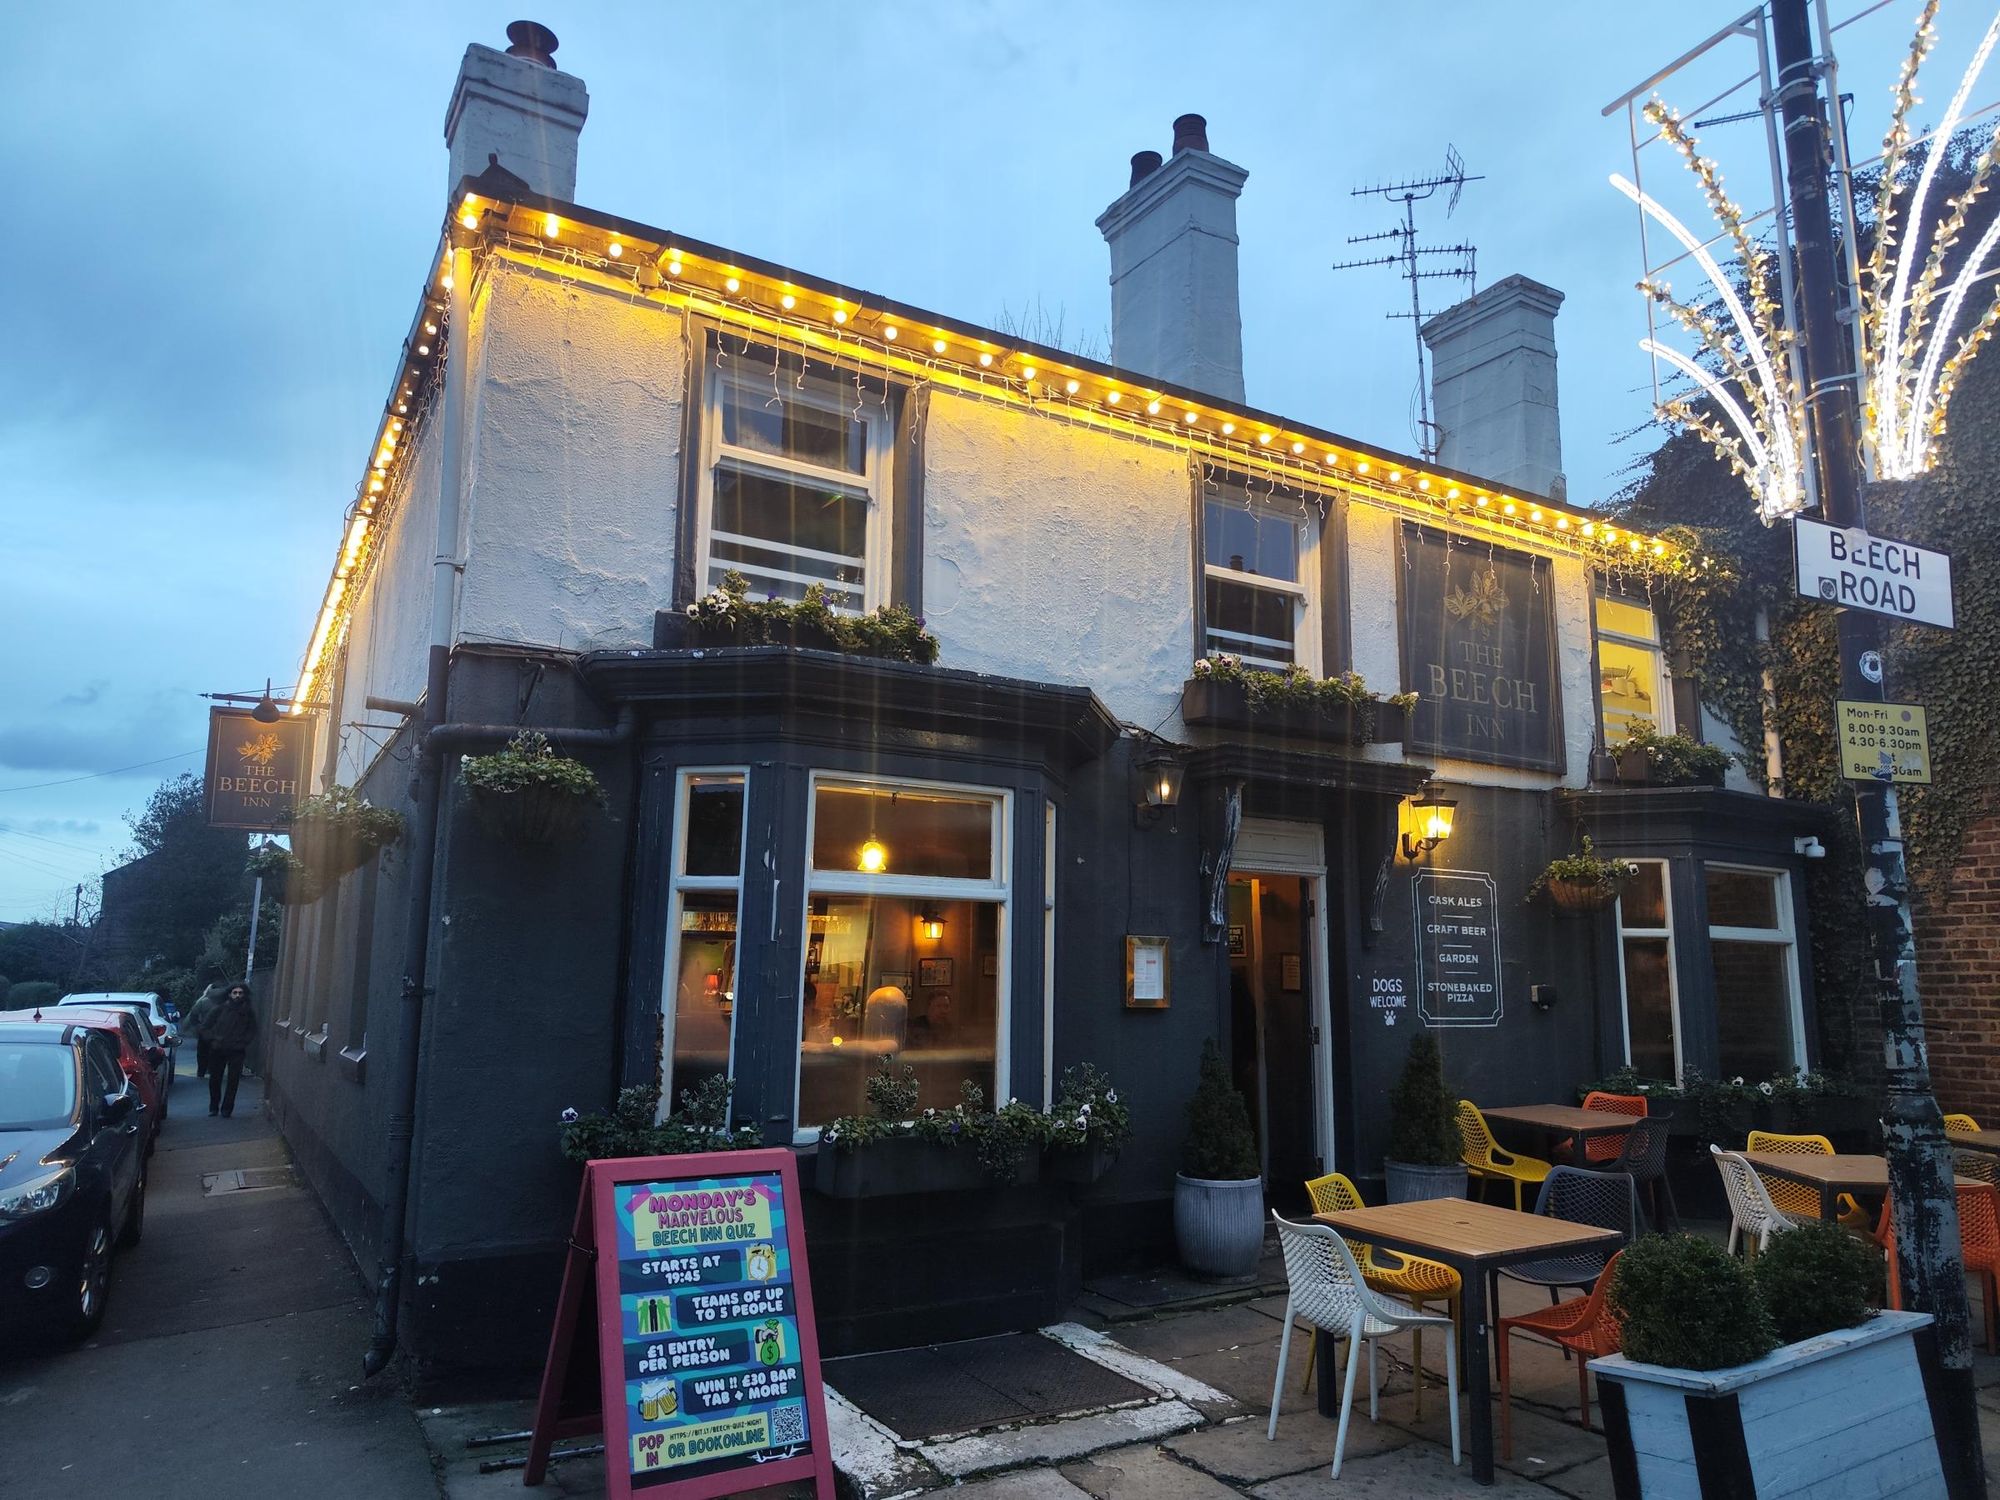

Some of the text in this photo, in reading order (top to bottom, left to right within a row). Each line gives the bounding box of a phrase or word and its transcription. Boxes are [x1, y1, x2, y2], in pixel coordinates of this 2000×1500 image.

[1841, 571, 1915, 614] ROAD
[1459, 640, 1505, 670] THE
[1427, 664, 1539, 714] BEECH
[1847, 708, 1888, 719] Mon-Fri
[1466, 712, 1506, 740] INN
[1848, 723, 1920, 736] 8.00-9.30am
[1849, 737, 1921, 750] 4.30-6.30pm
[244, 765, 275, 776] THE
[219, 777, 297, 794] BEECH
[242, 797, 270, 807] INN
[1428, 896, 1482, 907] CASK ALES
[1427, 924, 1486, 936] CRAFT BEER
[1439, 954, 1479, 964] GARDEN
[1373, 979, 1402, 993] DOGS
[1427, 983, 1493, 993] STONEBAKED
[1370, 996, 1407, 1008] WELCOME
[1447, 994, 1475, 1003] PIZZA
[649, 1189, 756, 1214] MONDAY'S
[658, 1207, 743, 1229] MARVELOUS
[652, 1223, 756, 1246] BEECH INN QUIZ
[641, 1255, 721, 1274] STARTS AT
[665, 1270, 701, 1285] 19:45
[692, 1288, 784, 1309] TEAMS OF UP
[695, 1300, 783, 1321] TO 5 PEOPLE
[647, 1337, 716, 1359] £1 ENTRY
[639, 1348, 730, 1373] PER PERSON
[695, 1379, 725, 1395] WIN
[741, 1373, 765, 1389] £30
[770, 1367, 797, 1384] BAR
[702, 1391, 730, 1407] TAB
[748, 1382, 788, 1400] MORE
[639, 1433, 664, 1452] POP
[668, 1442, 686, 1458] OR
[646, 1450, 659, 1467] IN
